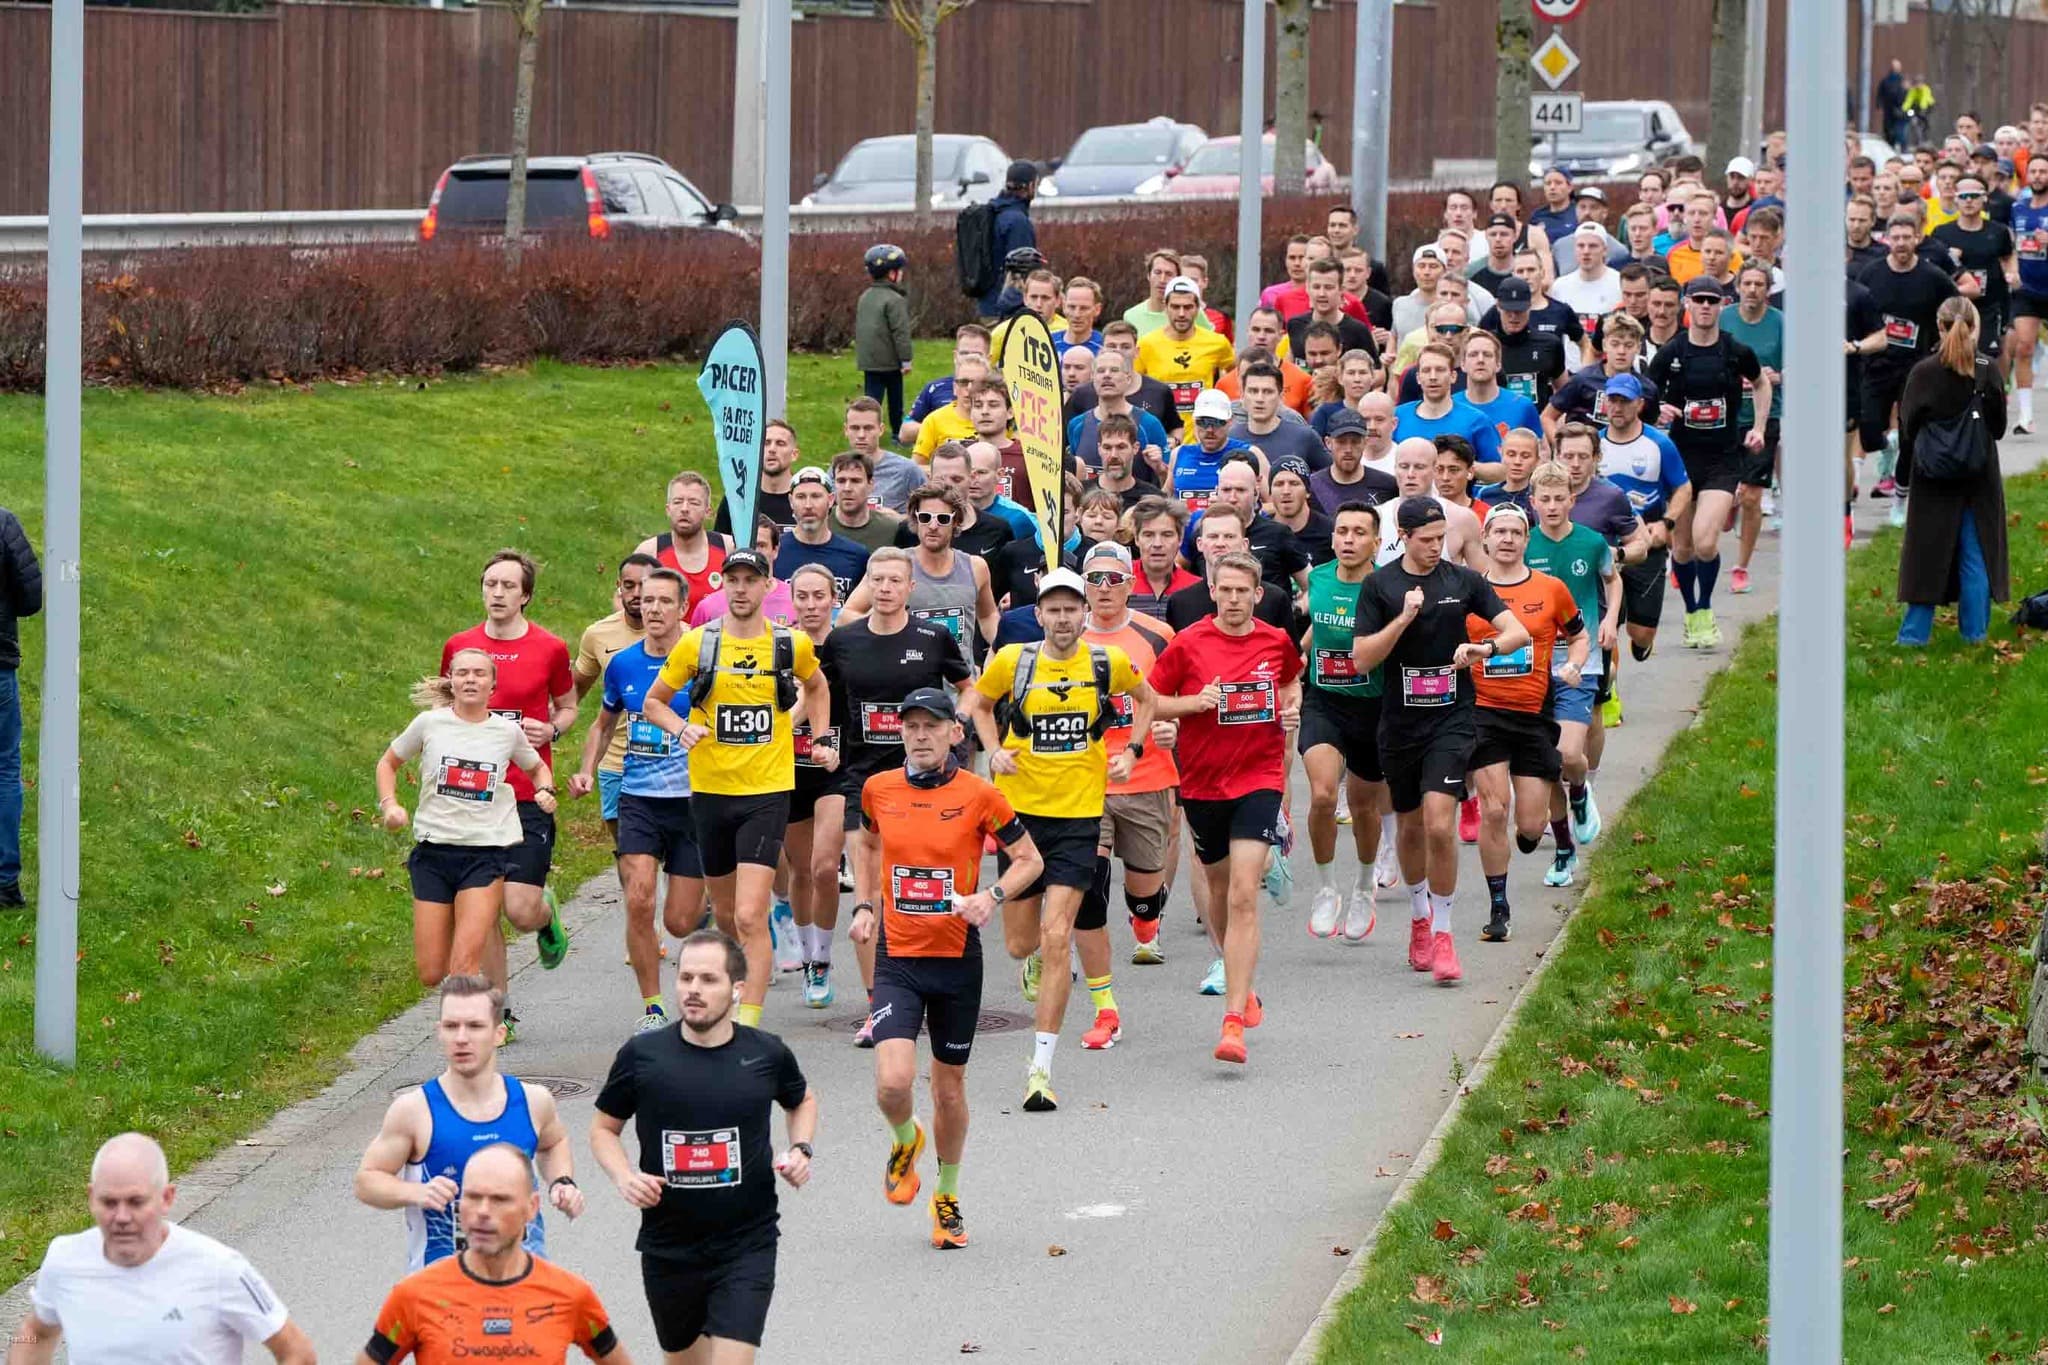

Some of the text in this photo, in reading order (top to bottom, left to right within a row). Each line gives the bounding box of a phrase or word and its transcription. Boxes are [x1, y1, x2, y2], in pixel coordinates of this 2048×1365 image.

[1536, 103, 1572, 123] 441
[711, 363, 757, 394] PACER
[729, 552, 756, 563] HOKA
[1313, 611, 1356, 628] KLEIVANE
[721, 709, 770, 733] 1:30
